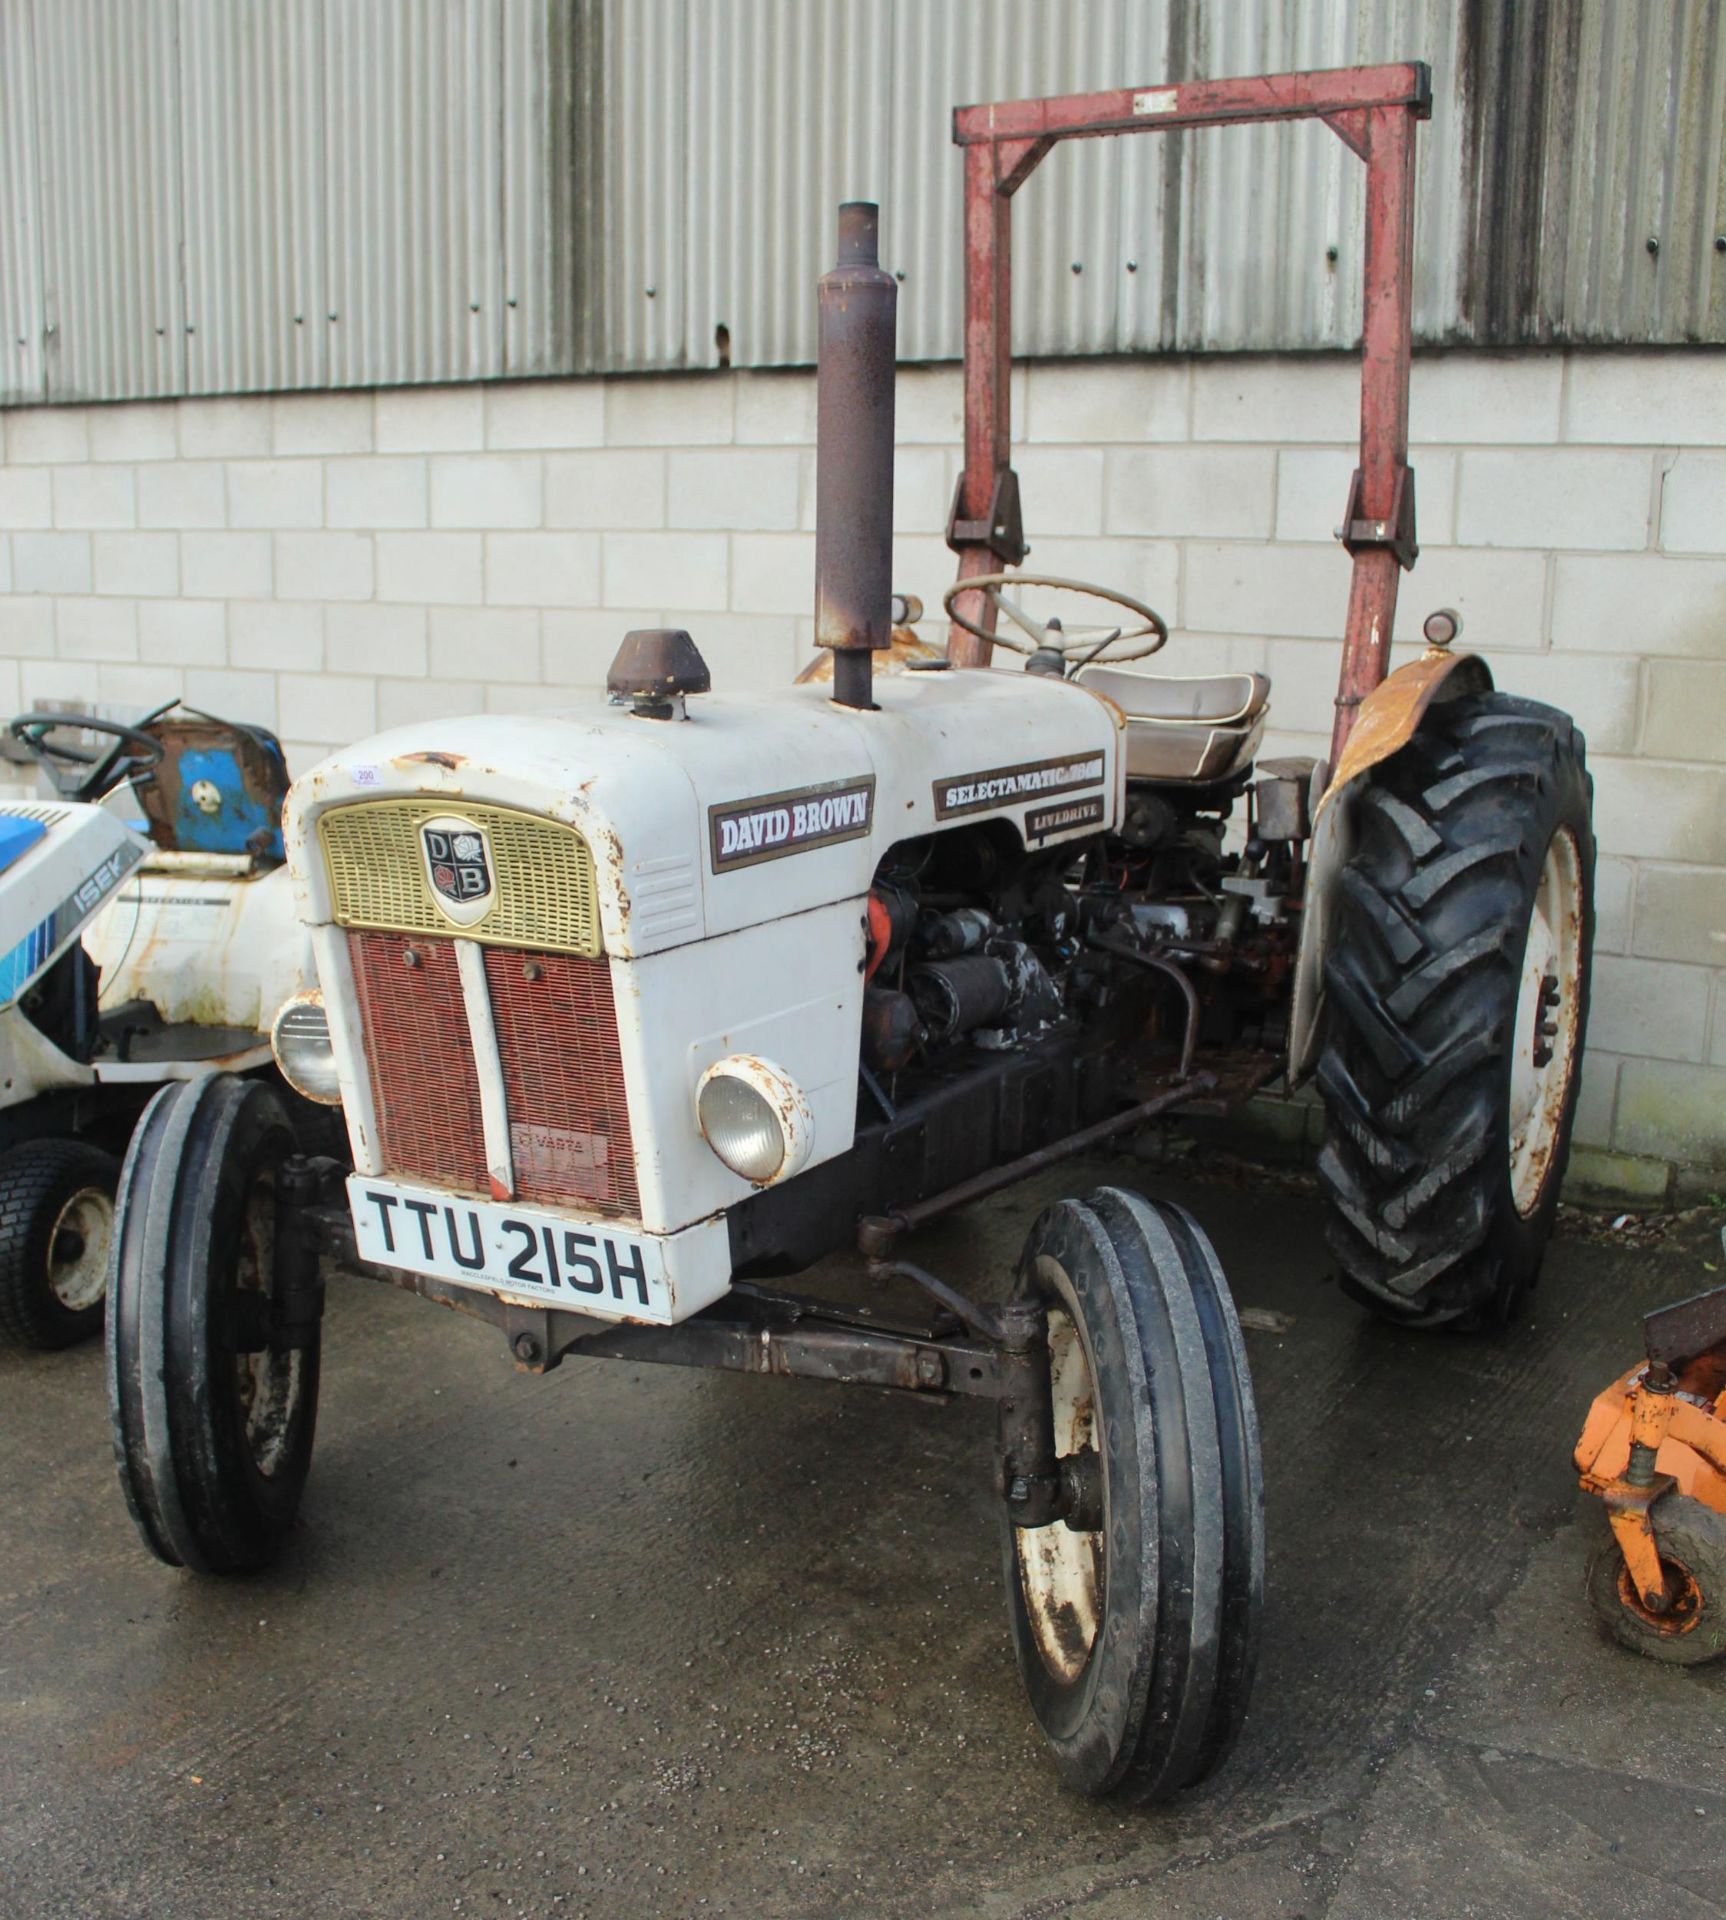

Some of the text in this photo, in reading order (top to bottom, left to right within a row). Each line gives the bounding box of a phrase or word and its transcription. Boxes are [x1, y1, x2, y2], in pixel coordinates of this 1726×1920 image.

[945, 767, 1066, 808] SELECTAMATIC
[721, 791, 868, 854] DAVID BROWN
[1034, 803, 1097, 830] LIVEDRIVE
[428, 833, 448, 859] D
[459, 867, 486, 893] B
[366, 1191, 650, 1306] TTU 215H
[506, 1278, 526, 1289] MOTOR
[527, 1283, 555, 1294] FACTORS
